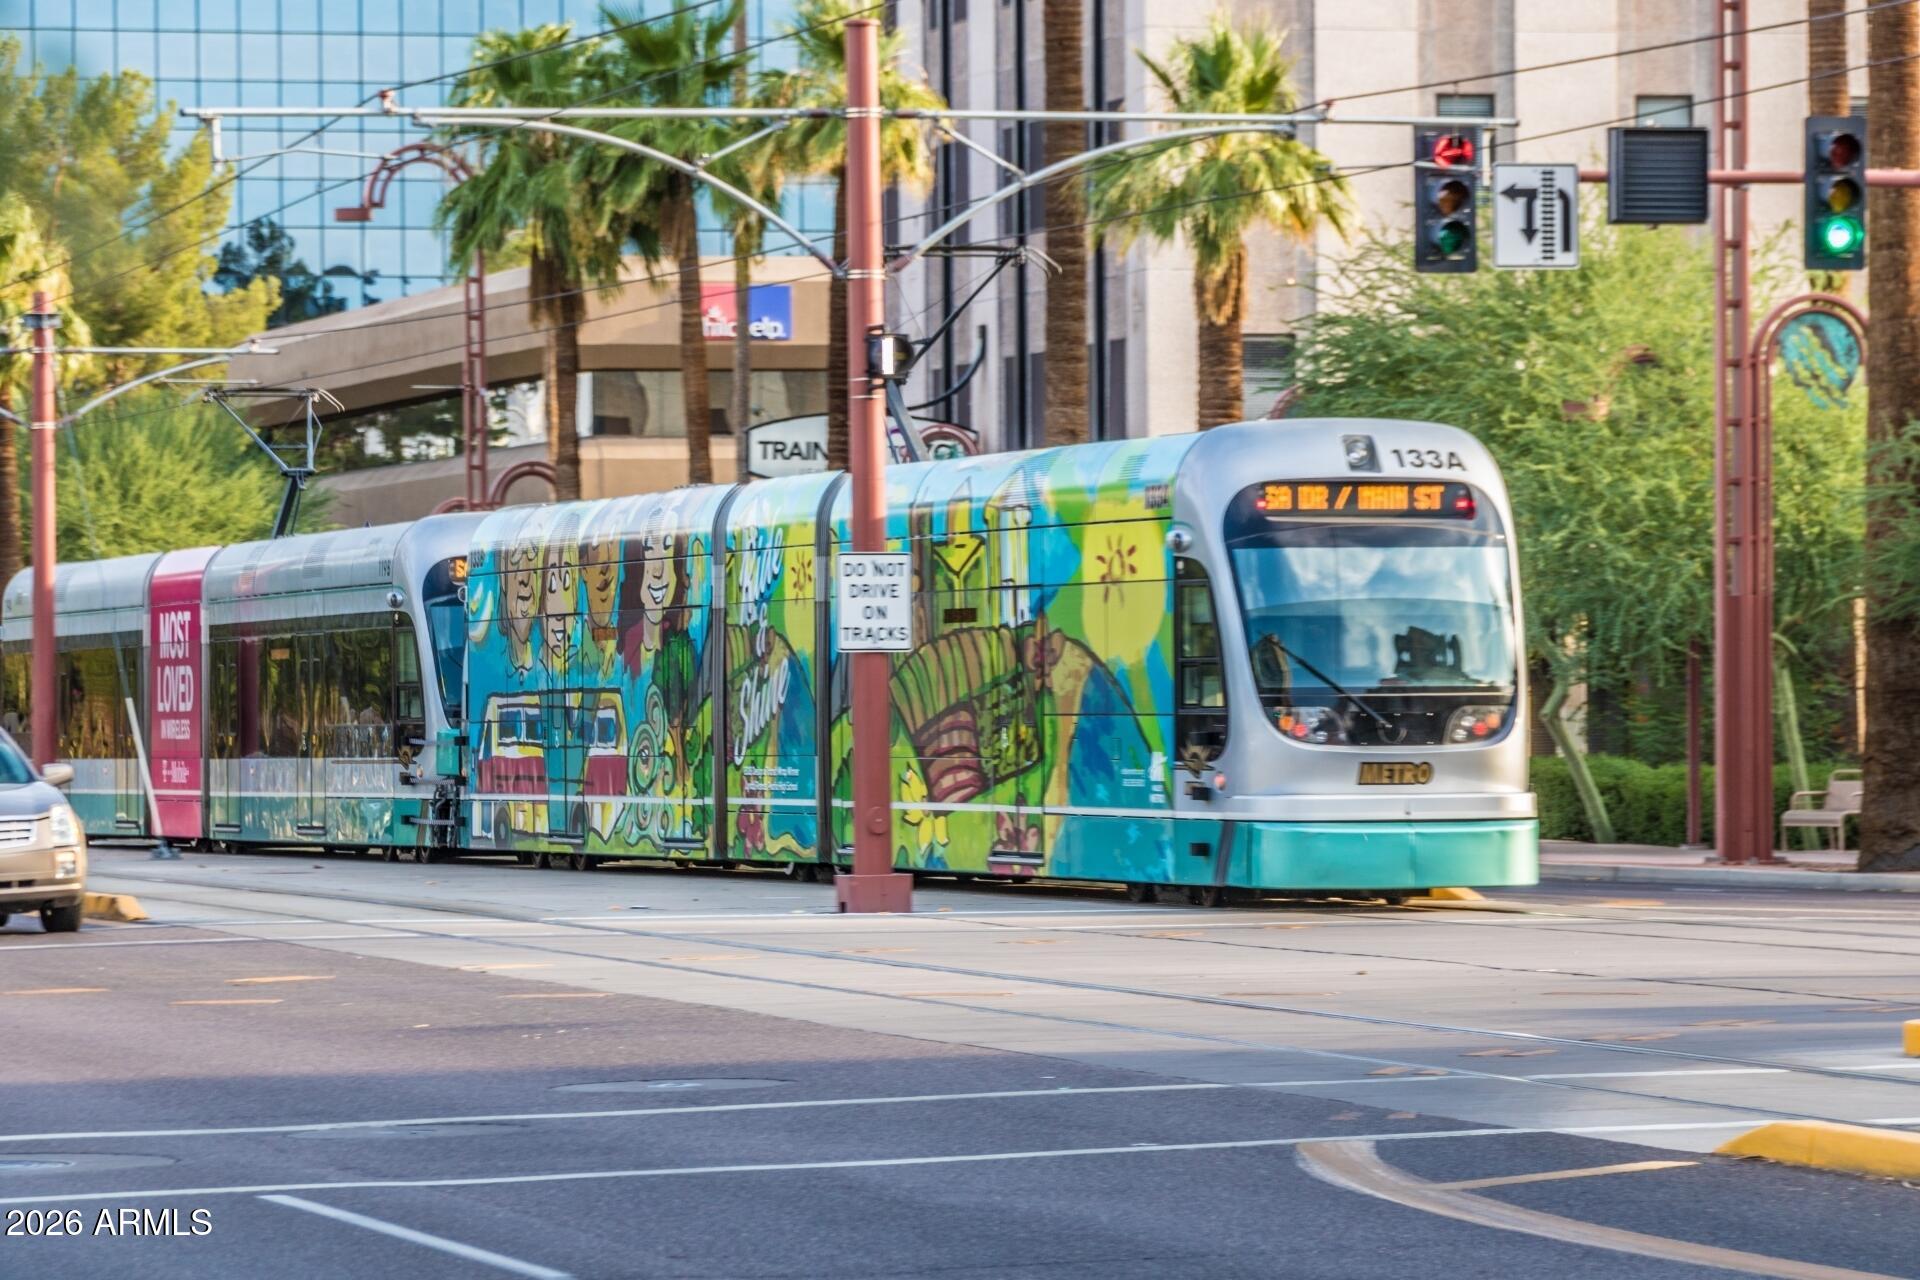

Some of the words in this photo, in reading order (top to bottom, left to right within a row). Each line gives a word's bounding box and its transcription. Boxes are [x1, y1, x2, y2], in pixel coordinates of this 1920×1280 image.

[1392, 449, 1467, 471] 133A
[1413, 485, 1445, 510] ST
[843, 563, 867, 577] DO
[872, 562, 905, 577] NOT
[849, 584, 900, 598] DRIVE
[864, 606, 888, 620] ON
[159, 611, 191, 659] MOST
[841, 627, 908, 641] TRACKS
[157, 665, 194, 713] LOVED
[734, 657, 791, 767] Shine
[167, 719, 190, 740] WIRELESS
[1358, 762, 1433, 784] METRO
